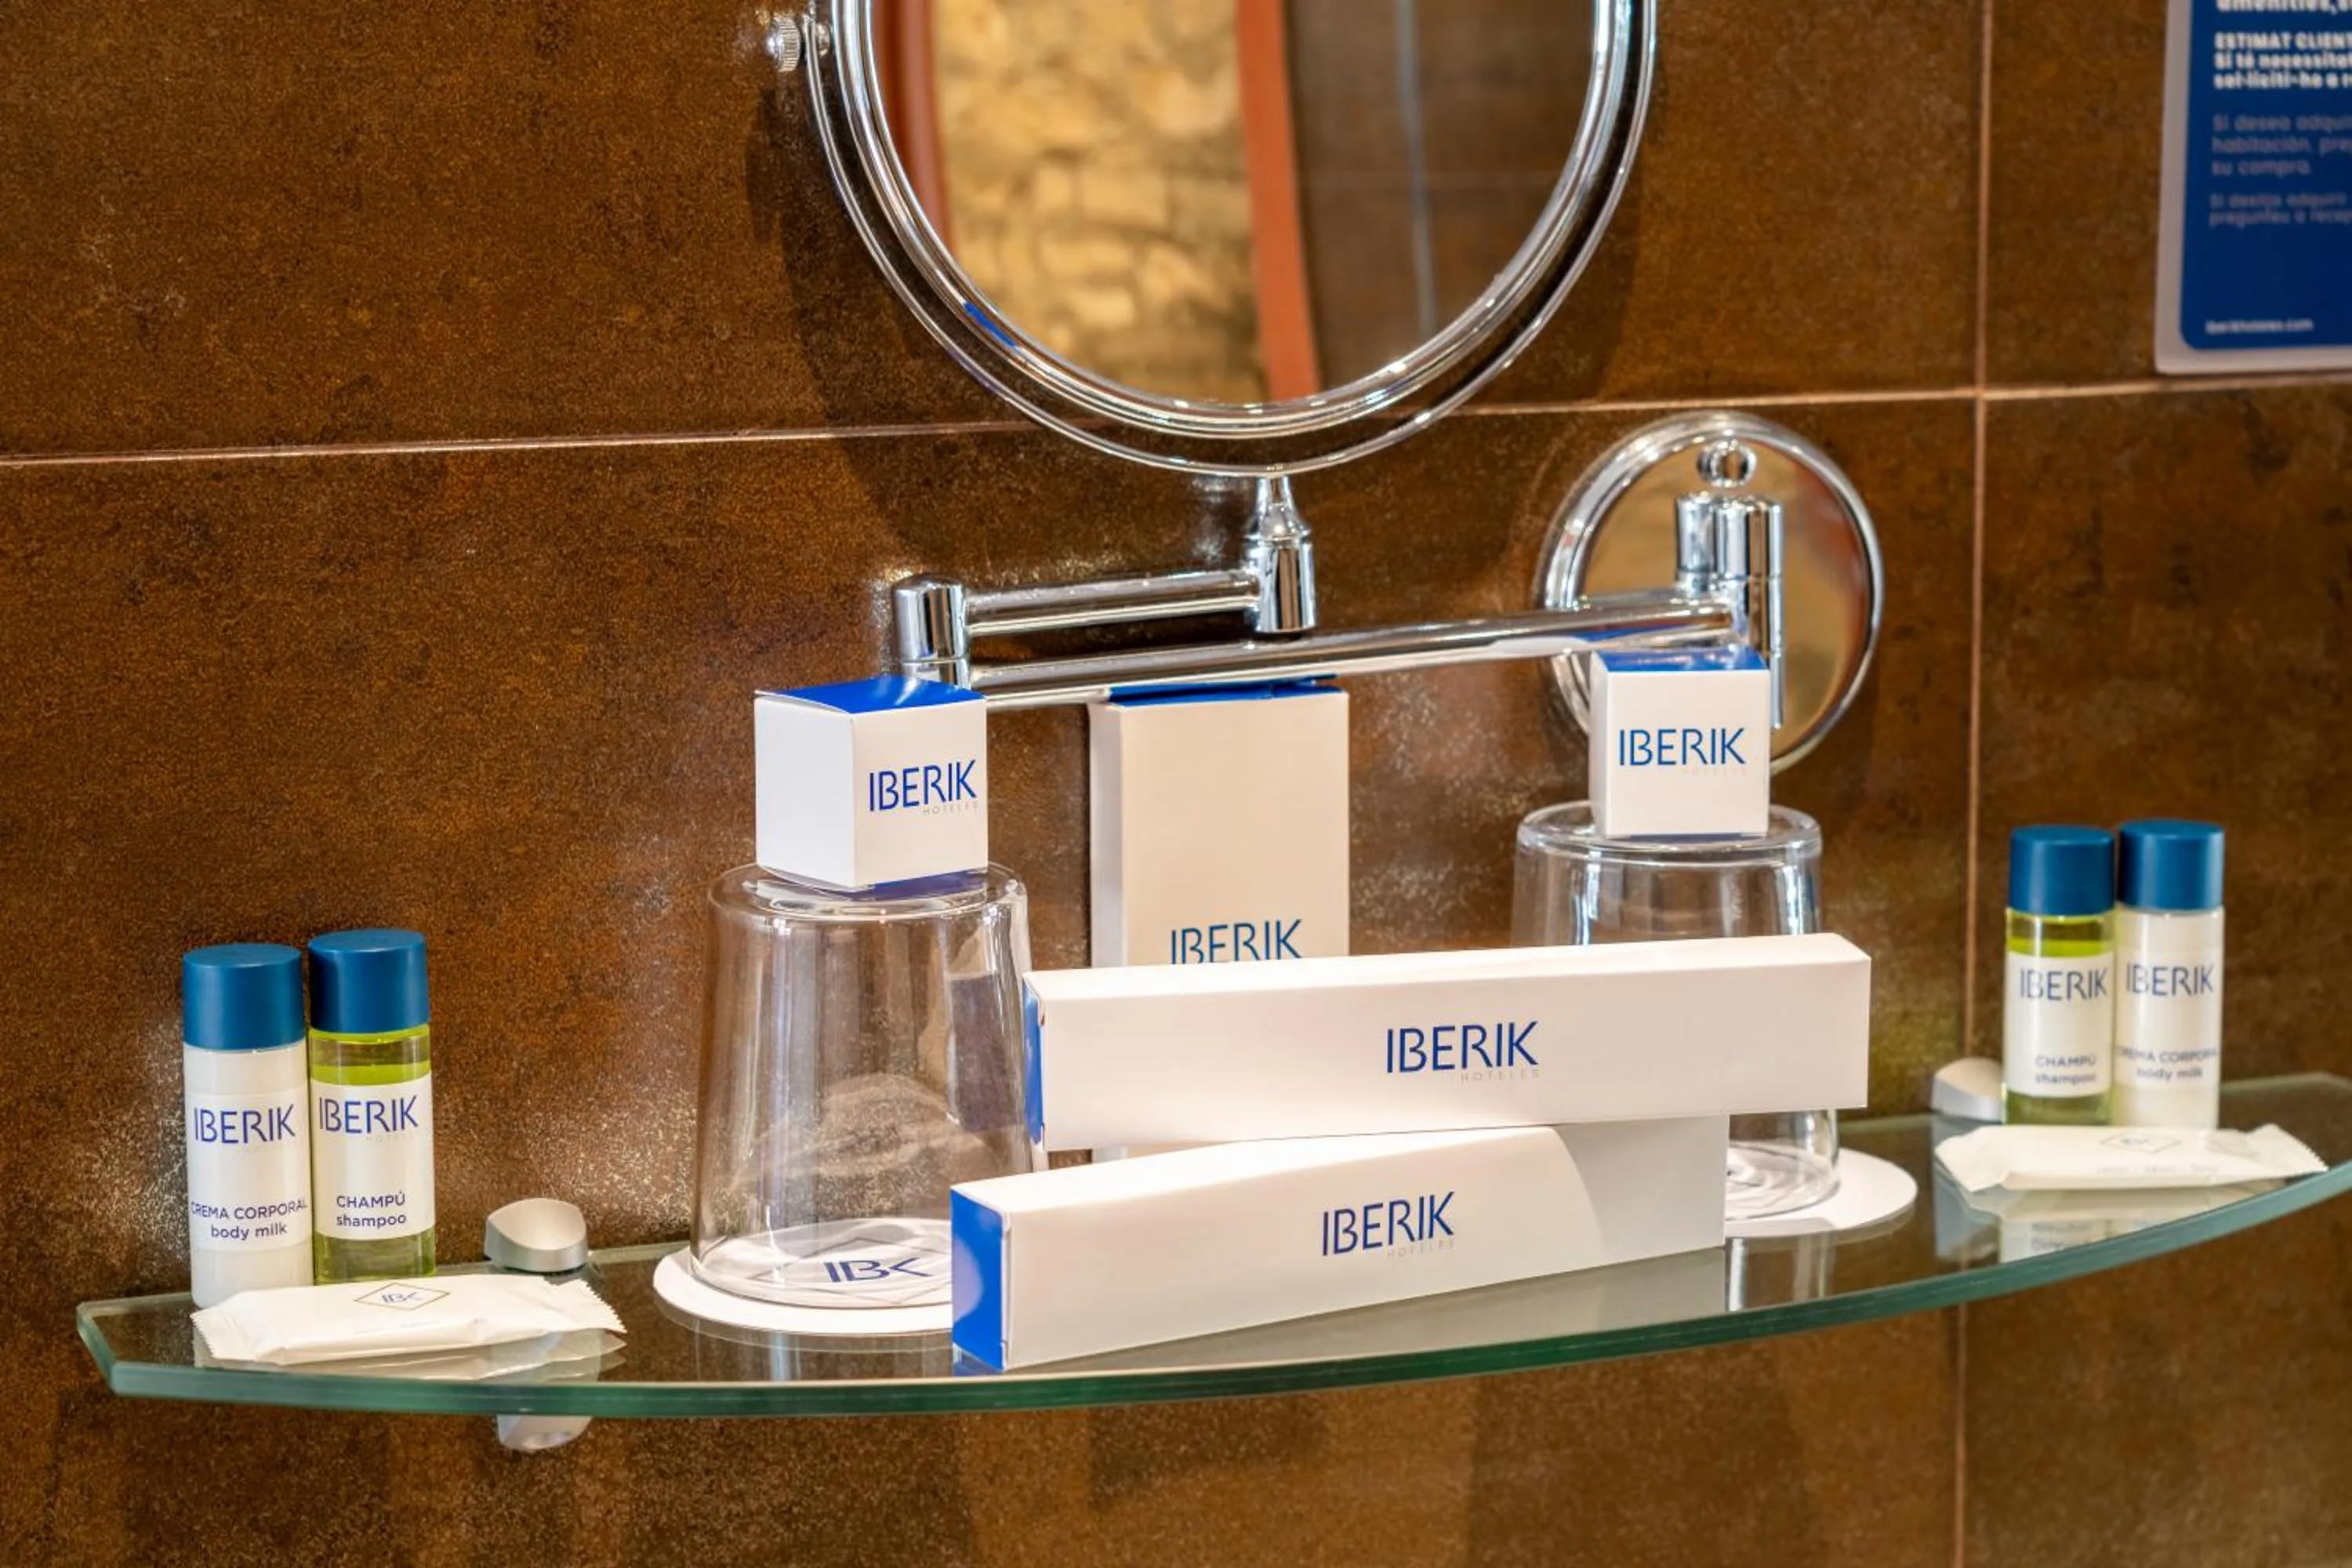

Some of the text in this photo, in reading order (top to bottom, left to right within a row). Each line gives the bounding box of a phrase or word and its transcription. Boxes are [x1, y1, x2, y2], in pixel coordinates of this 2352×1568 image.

[2214, 31, 2291, 50] ESTIMAT
[2213, 52, 2232, 70] Si
[1617, 727, 1746, 766] IBERIK
[869, 759, 978, 812] IBERIK
[1171, 918, 1303, 964] IBERIK
[2020, 967, 2108, 1001] IBERIK
[2125, 964, 2215, 996] IBERIK
[1386, 1021, 1539, 1073] IBERIK
[194, 1103, 296, 1144] IBERIK
[318, 1094, 419, 1134] IBERIK
[233, 1198, 308, 1220] CORPORAL
[336, 1191, 406, 1209] CHAMPÚ
[210, 1221, 288, 1241] body milk
[336, 1213, 407, 1229] shampoo
[1322, 1191, 1455, 1256] IBERIK
